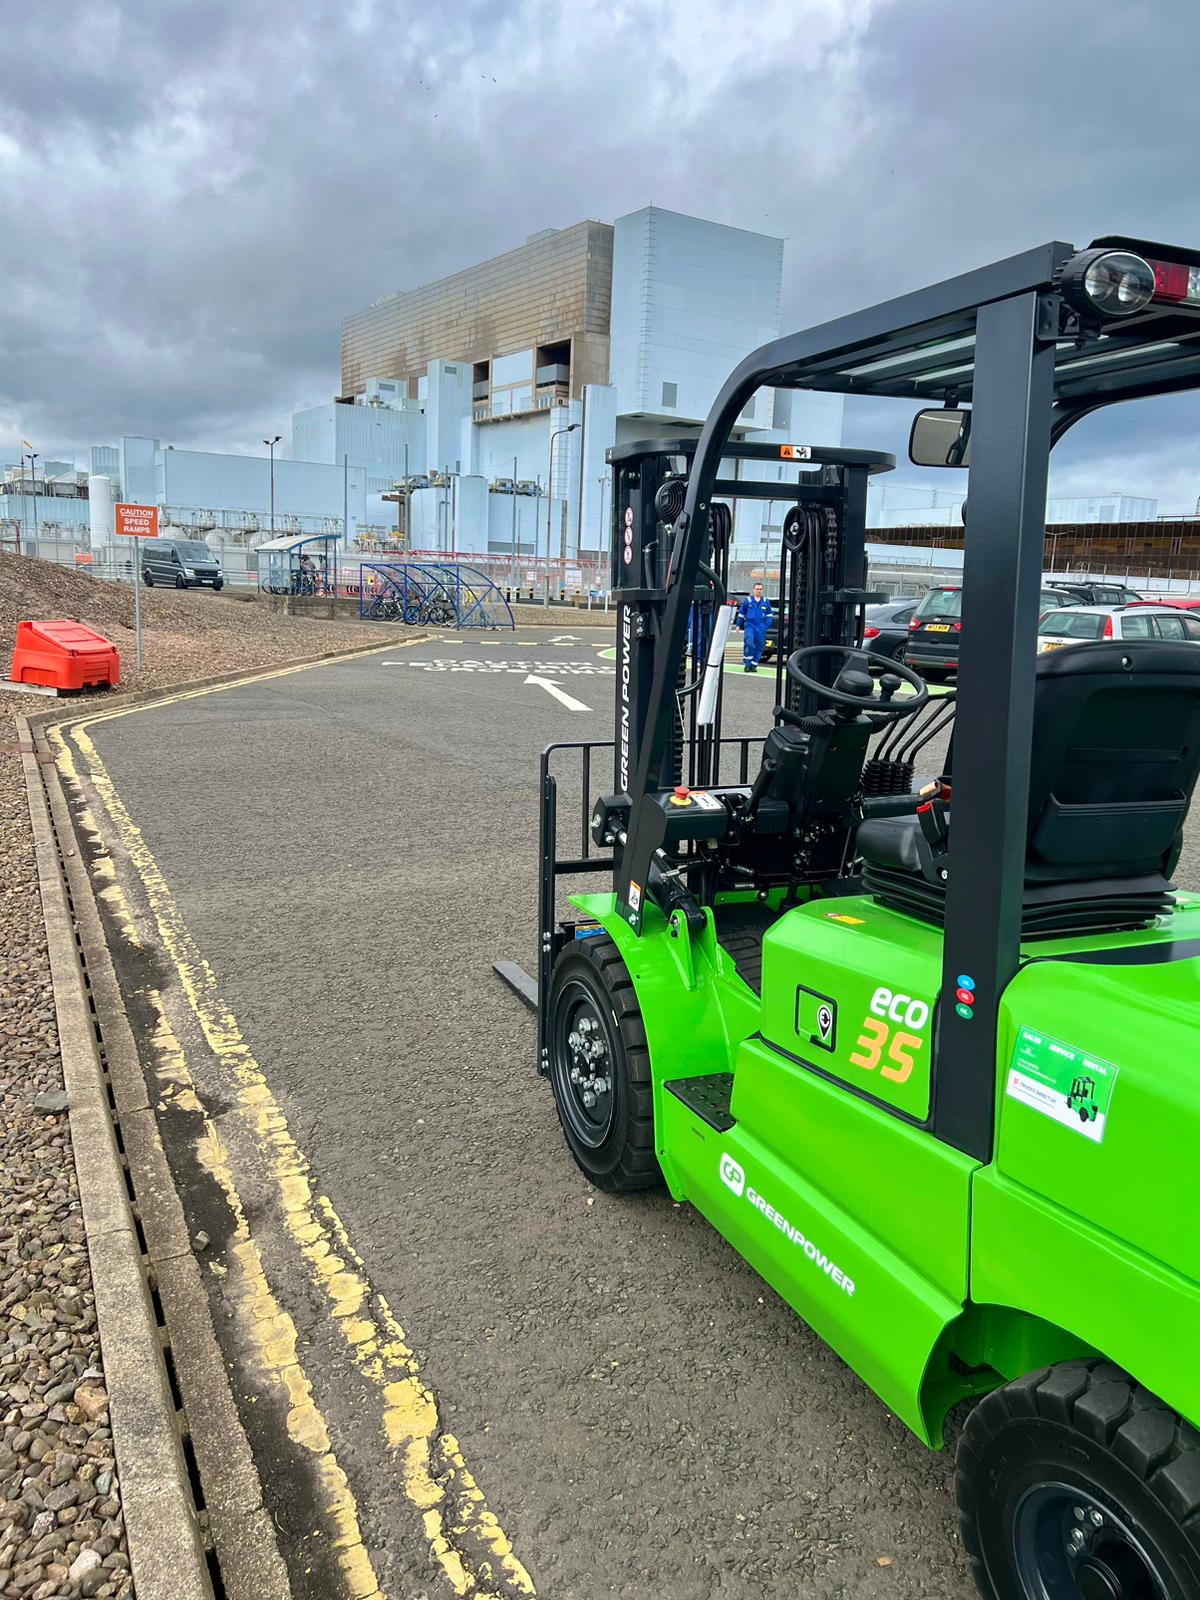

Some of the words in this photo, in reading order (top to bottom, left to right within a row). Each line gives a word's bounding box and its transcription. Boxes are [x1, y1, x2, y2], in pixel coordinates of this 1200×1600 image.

[120, 508, 153, 517] CAUTION
[123, 525, 151, 533] RAMPS
[124, 518, 150, 526] SPEED
[622, 604, 632, 703] POWER
[620, 705, 630, 792] GREEN
[870, 987, 929, 1030] eco
[850, 1016, 923, 1084] 35
[746, 1186, 856, 1297] GREENPOWER
